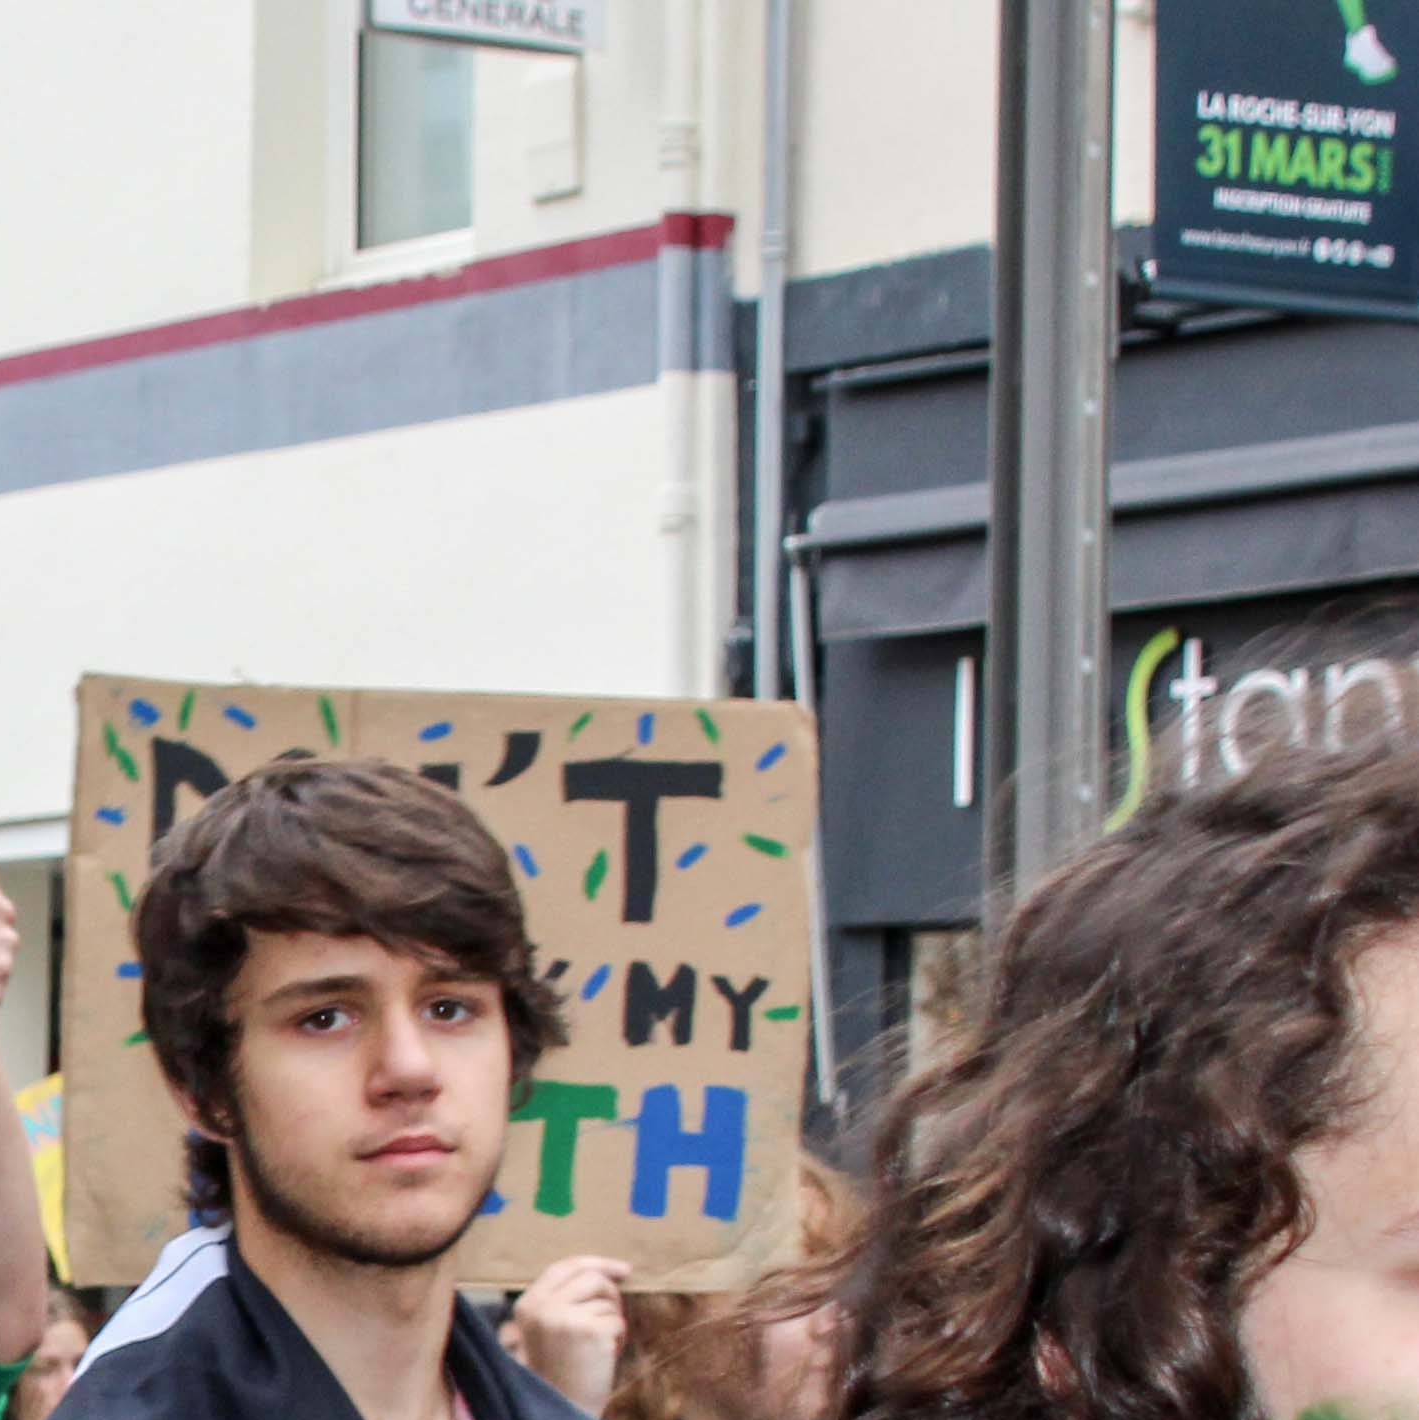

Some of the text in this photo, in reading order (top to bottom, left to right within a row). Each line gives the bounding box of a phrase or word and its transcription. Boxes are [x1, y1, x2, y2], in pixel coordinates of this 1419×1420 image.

[1196, 90, 1226, 120] LA
[1195, 124, 1243, 179] 31
[1248, 132, 1377, 194] MARS
[1104, 626, 1419, 834] Stan
[624, 960, 768, 1052] MY
